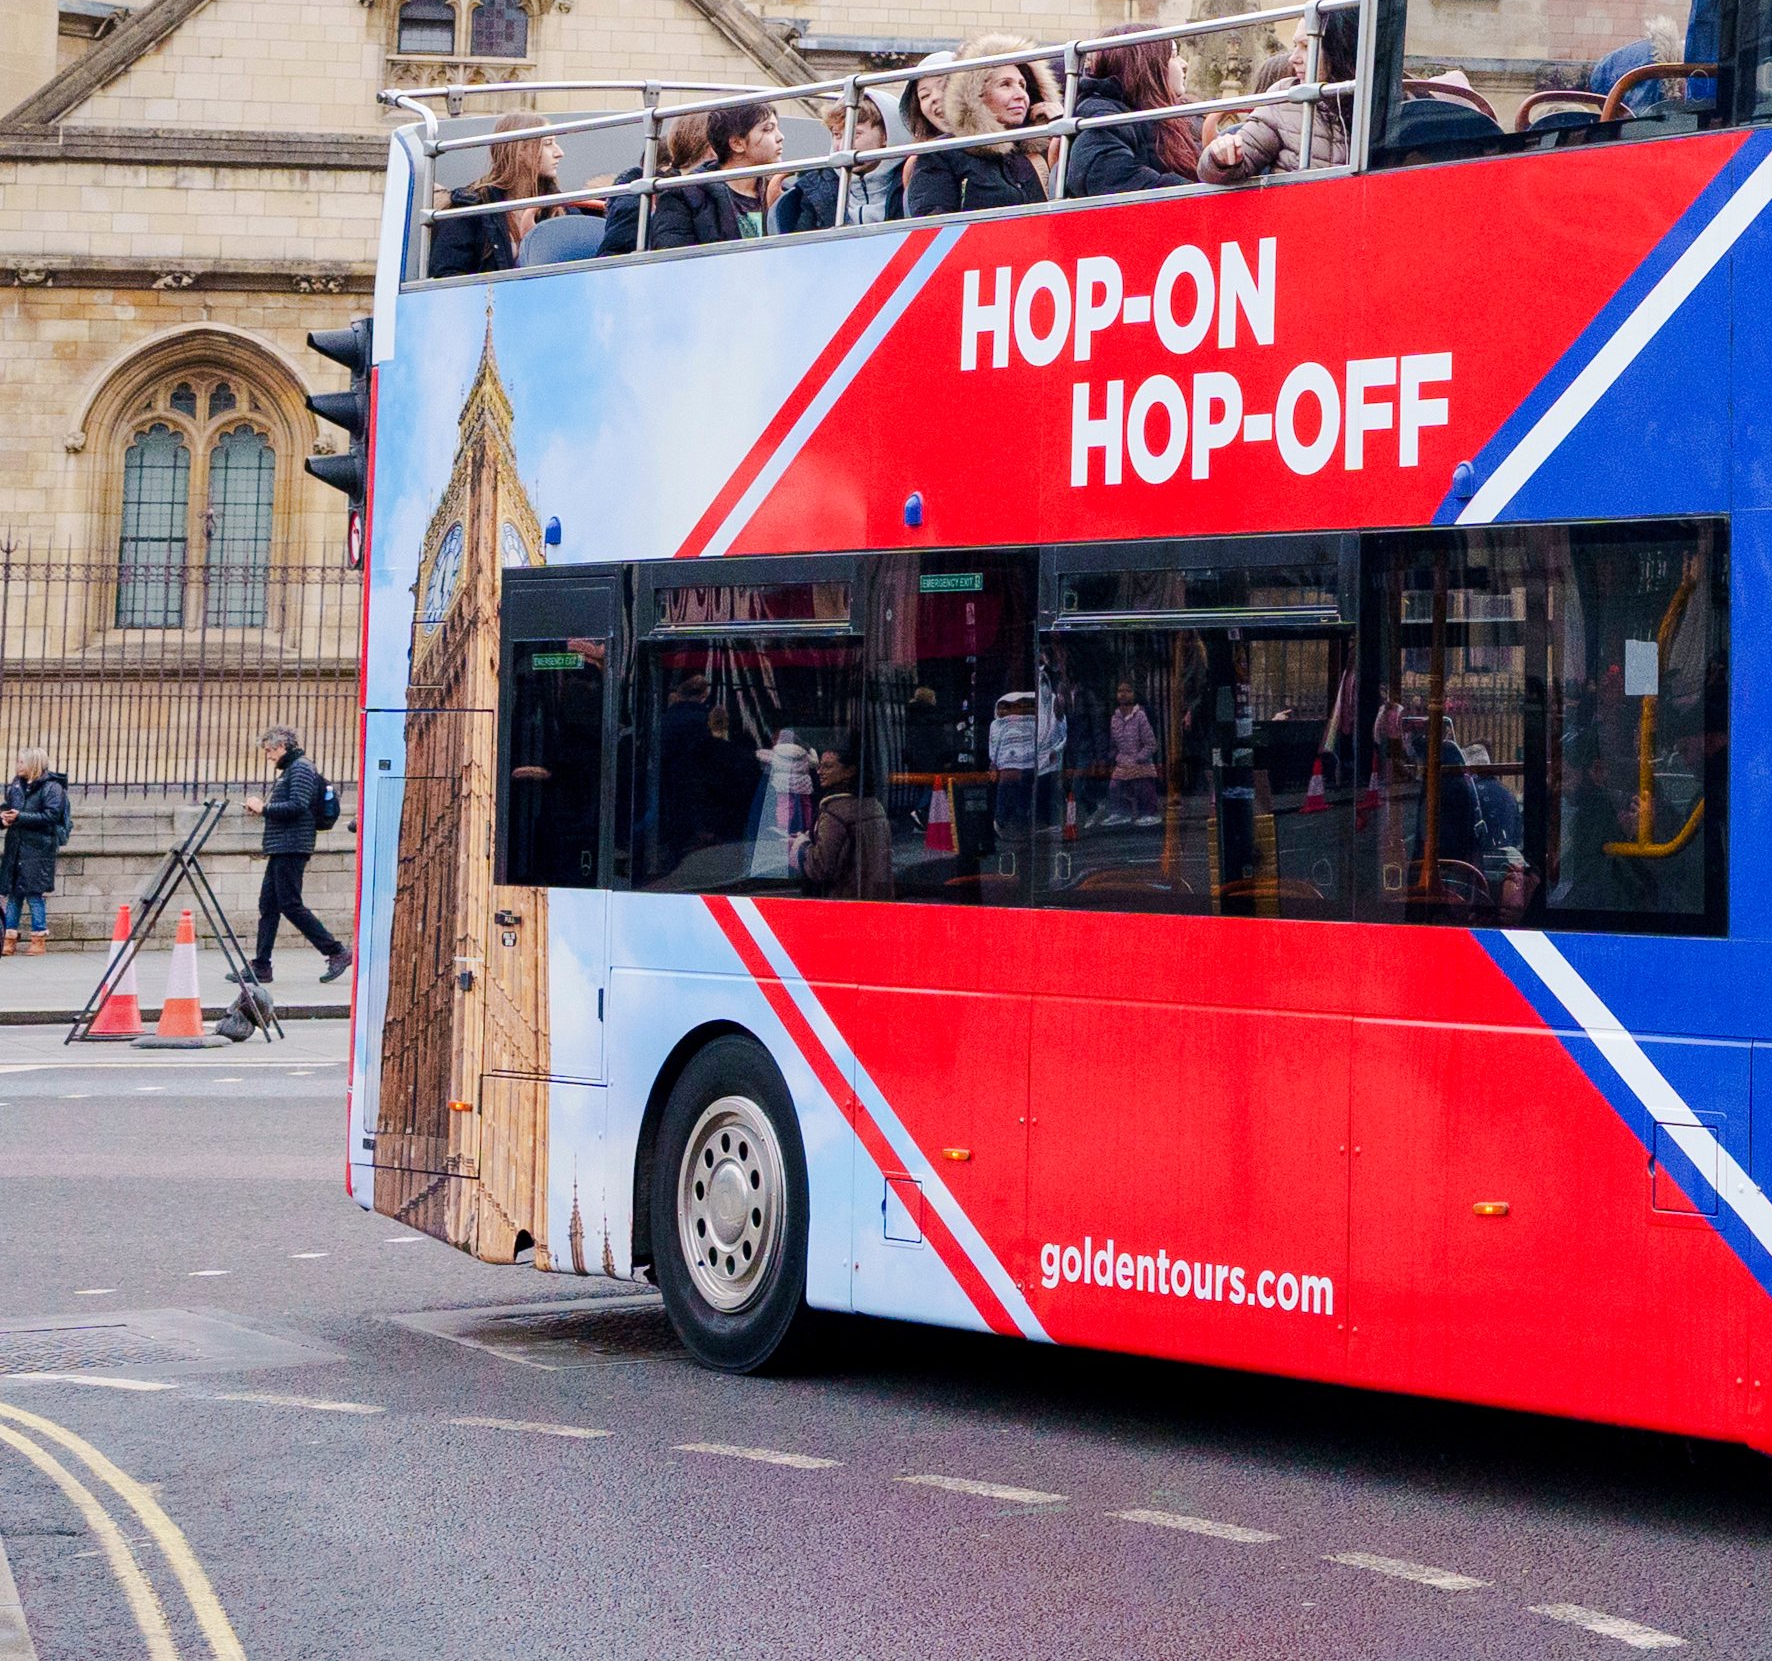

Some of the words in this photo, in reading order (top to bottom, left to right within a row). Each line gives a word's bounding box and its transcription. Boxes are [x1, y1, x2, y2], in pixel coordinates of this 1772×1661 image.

[960, 236, 1278, 372] HOP-ON
[1070, 351, 1454, 488] HOP-OFF
[1040, 1236, 1334, 1316] goldentours.com
